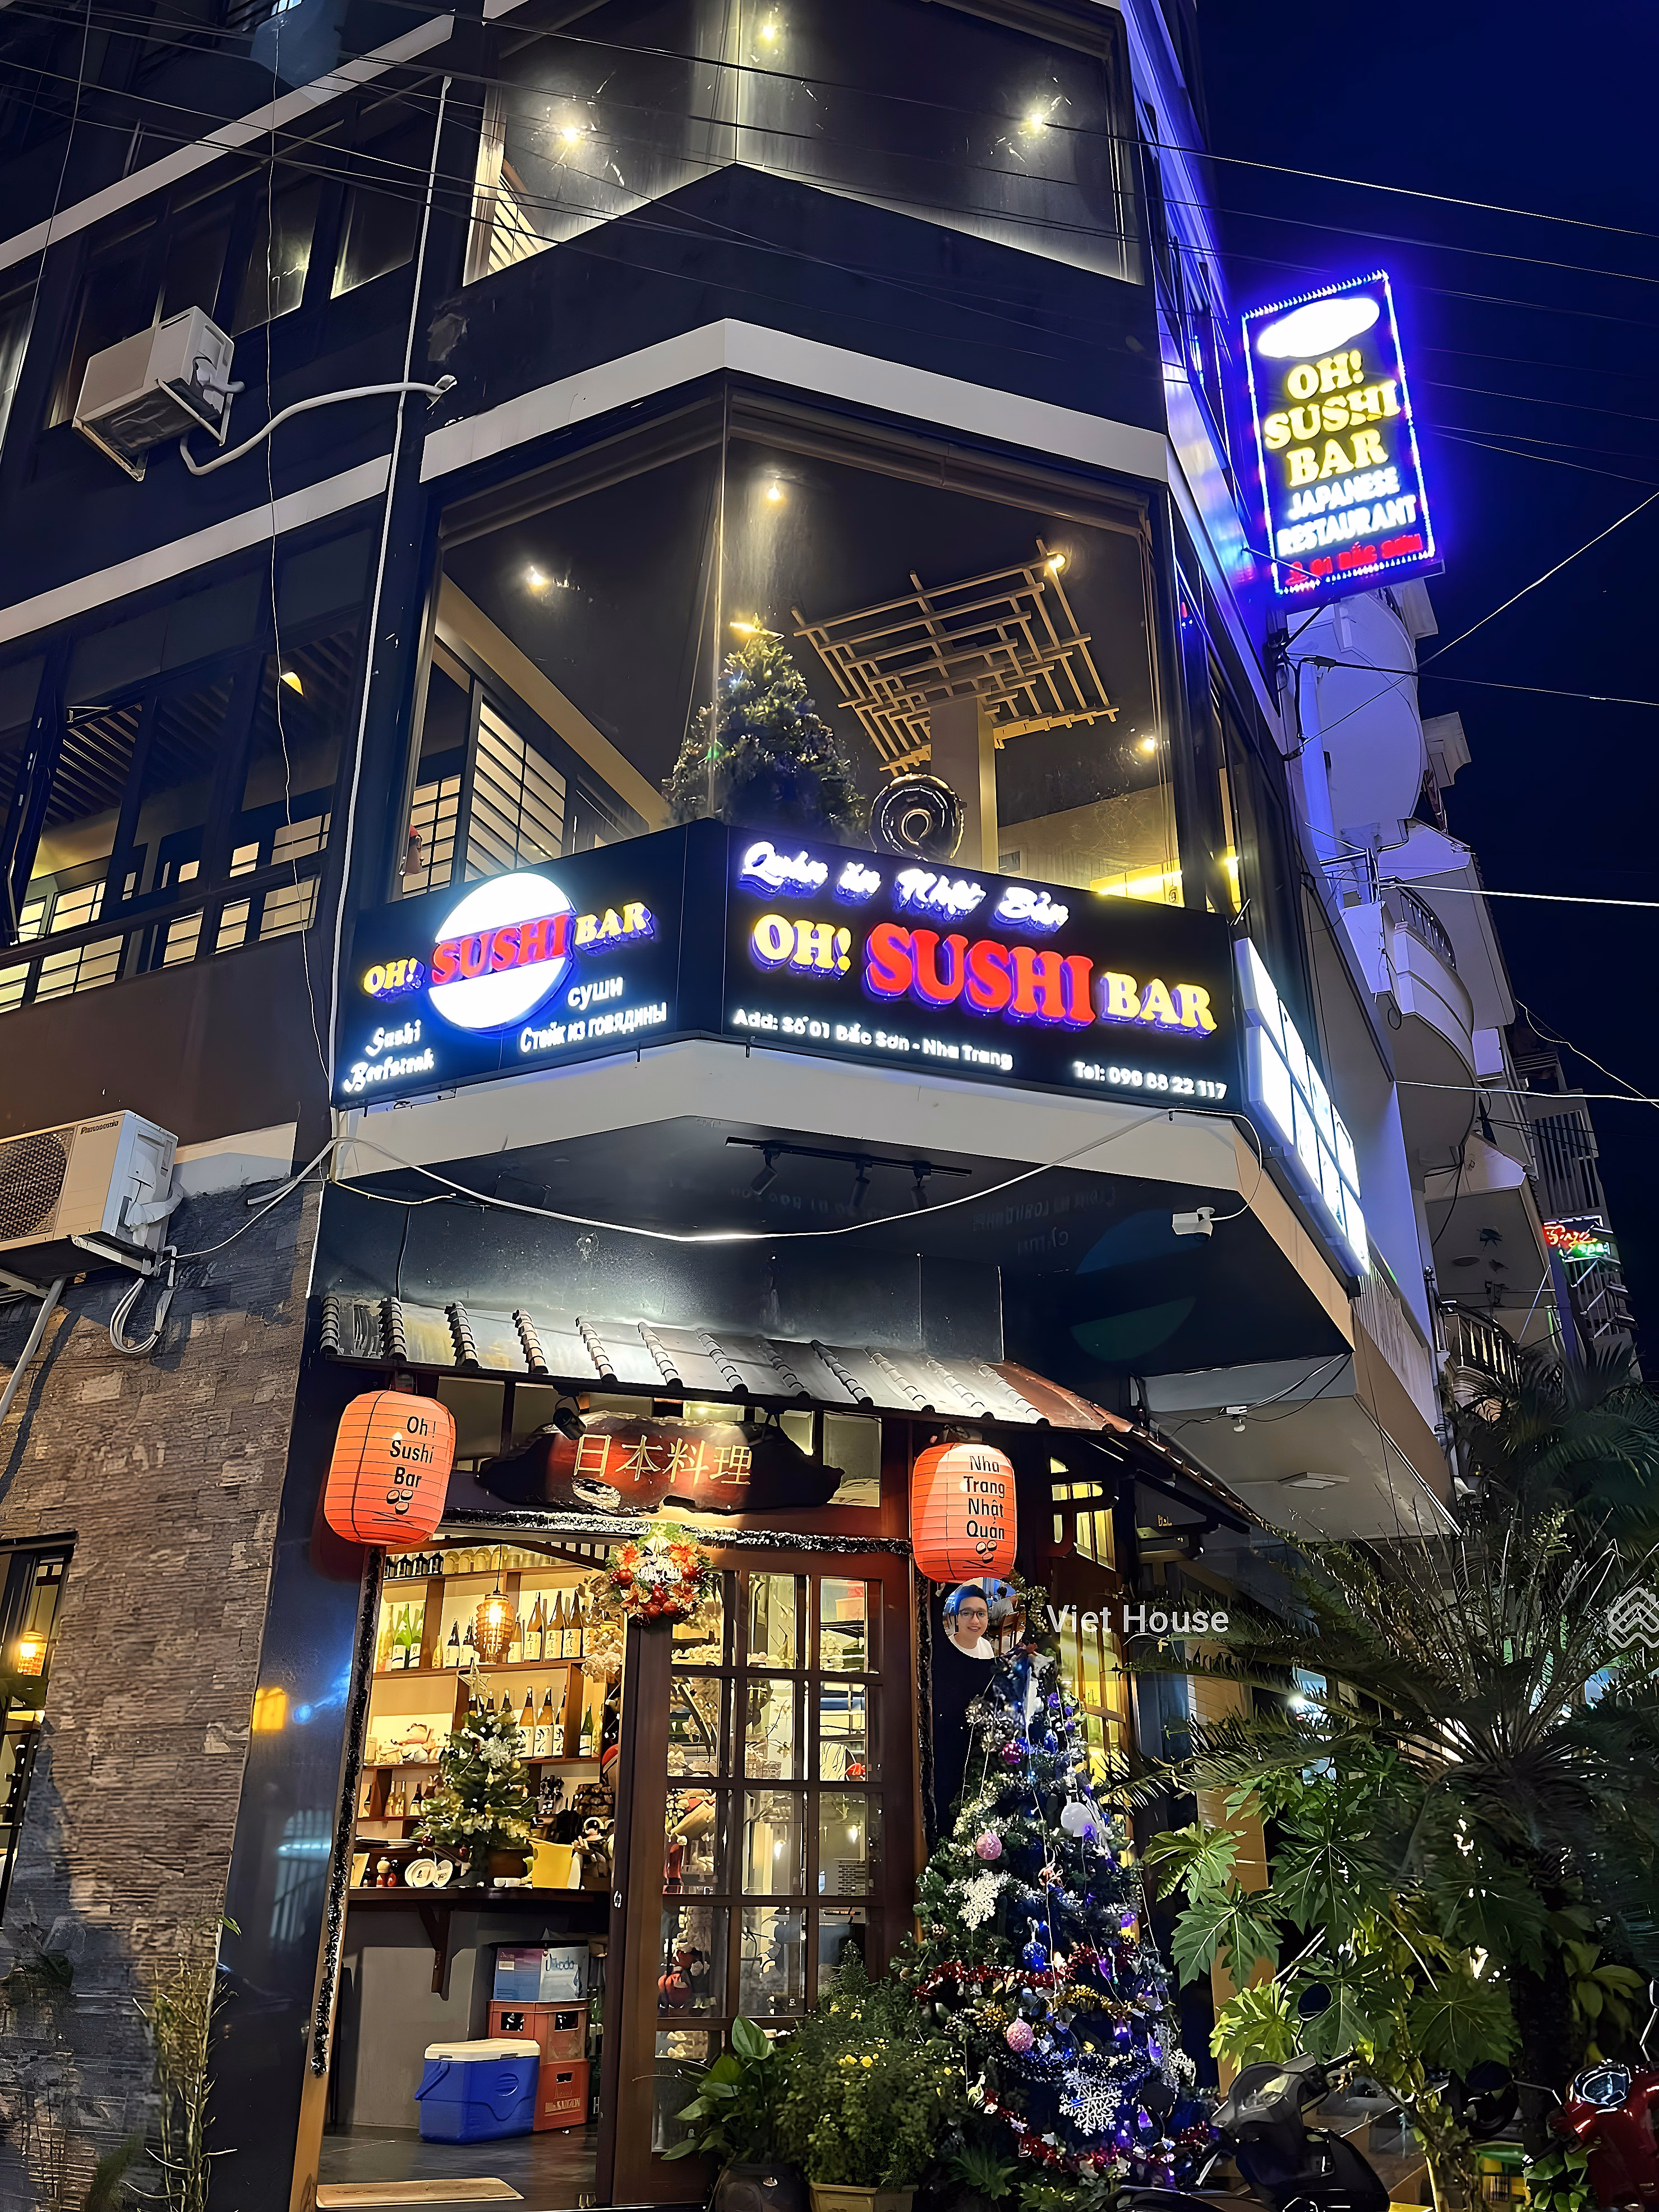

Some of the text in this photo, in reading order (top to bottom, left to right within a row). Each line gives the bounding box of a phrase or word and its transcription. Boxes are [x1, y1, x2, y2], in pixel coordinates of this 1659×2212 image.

[1287, 350, 1365, 400] OH!
[1264, 380, 1401, 450] SUSHI
[1287, 428, 1389, 487] BAR
[1288, 467, 1400, 521] JAPANESE
[1276, 495, 1417, 556] RESTAURANT
[363, 902, 654, 994] OH! SUSHI BAR
[753, 914, 1218, 1033] OH! SUSHI BAR
[734, 1008, 778, 1030] Add:
[809, 1021, 830, 1039] 01
[923, 1039, 959, 1059] Nha
[962, 1045, 1013, 1070] Trang
[1075, 1061, 1227, 1099] Tel: 090 88 22 117
[390, 1440, 435, 1464] Sushi
[394, 1466, 422, 1488] Bar
[573, 1434, 752, 1487] 日本料理
[970, 1455, 999, 1473] Nha
[963, 1476, 1005, 1498] Trang
[969, 1497, 1003, 1520] Nhật
[966, 1520, 1004, 1540] Quán
